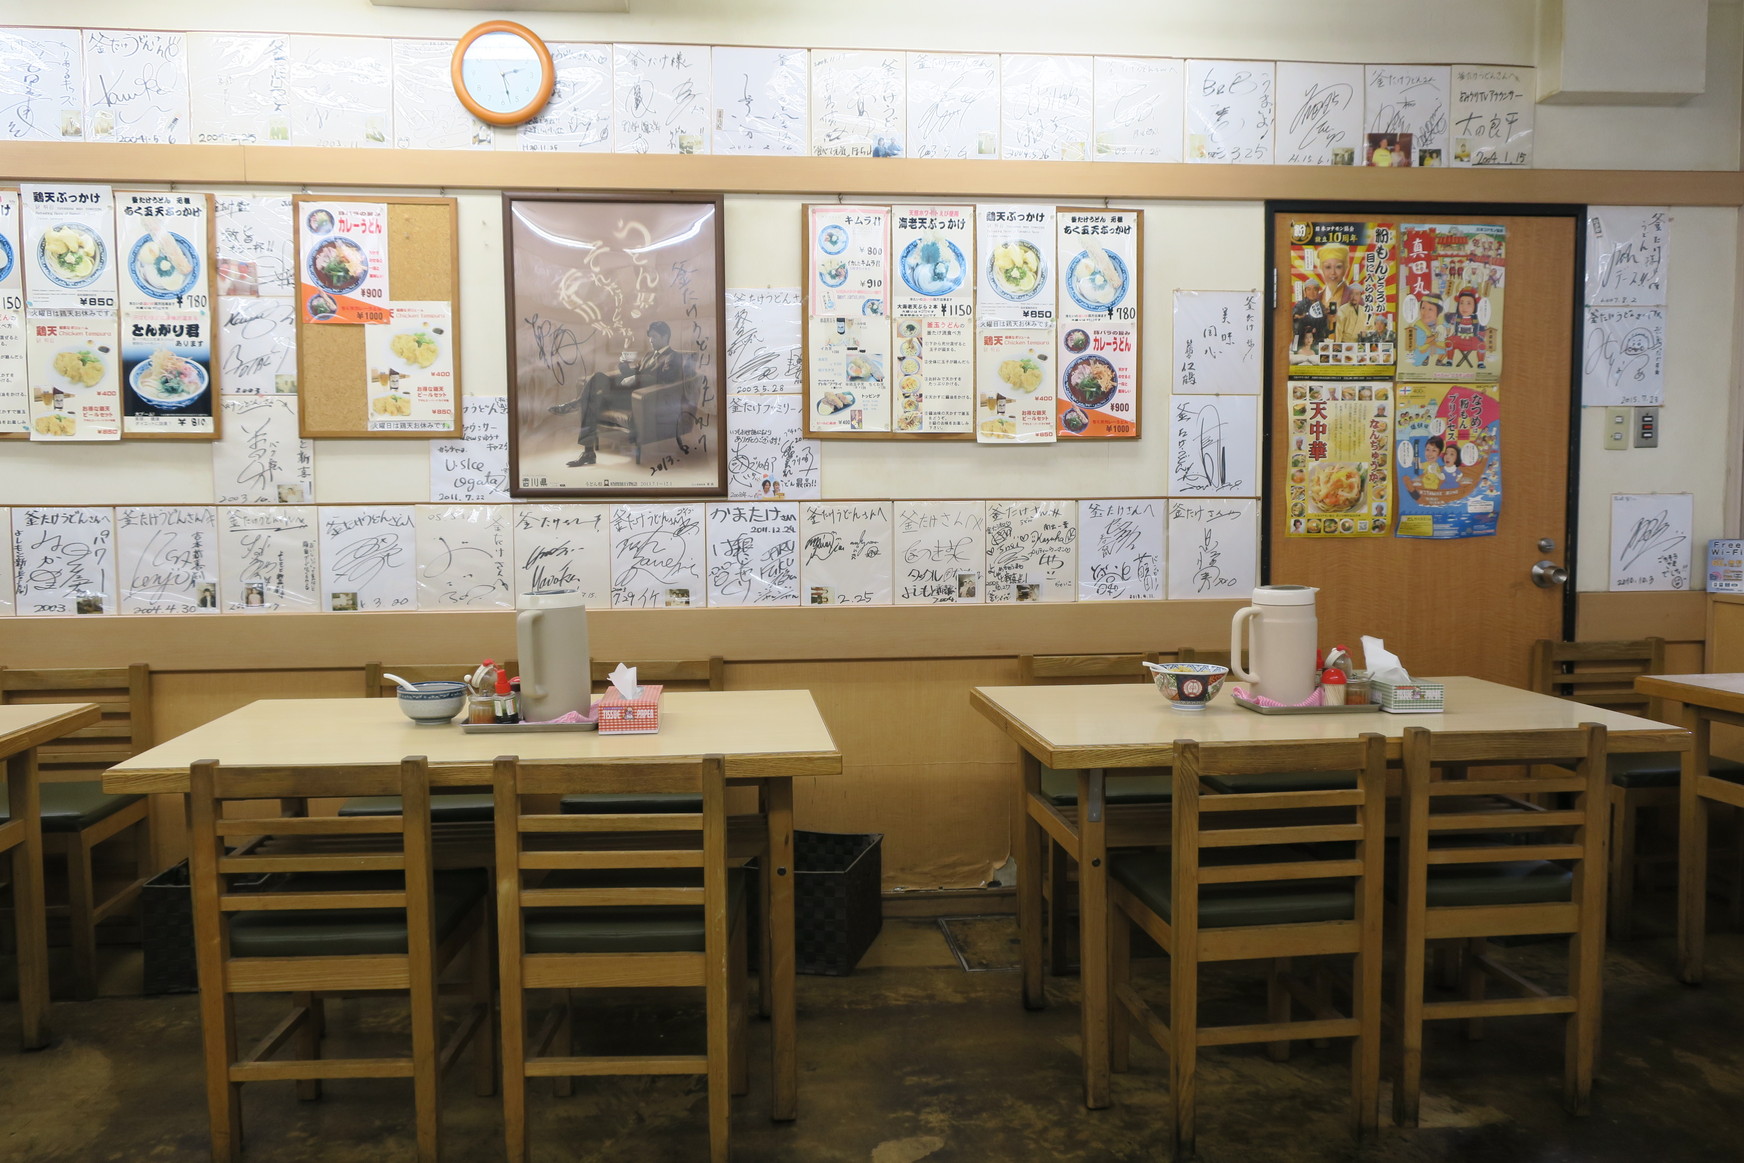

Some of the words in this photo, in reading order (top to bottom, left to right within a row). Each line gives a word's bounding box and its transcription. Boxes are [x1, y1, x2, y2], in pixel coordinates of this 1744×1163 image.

[33, 191, 100, 204] 鶏天ぶっかけ
[987, 211, 1045, 222] 鶏天ぶっかけ
[339, 217, 383, 234] カレーうどん
[898, 217, 967, 230] 海老天ぶっかけ
[1063, 226, 1132, 235] ちく玉天ぶっかけ
[1315, 232, 1358, 243] 設立10周年
[1374, 228, 1388, 313] 粉もんどころが
[1410, 238, 1430, 295] 真田丸
[361, 288, 383, 298] ¥900
[80, 298, 114, 306] ¥850
[356, 311, 383, 320] ¥1000
[941, 303, 972, 317] ¥1150
[1108, 307, 1136, 320] ¥780
[36, 326, 57, 337] 鶏天
[132, 324, 200, 338] とんがり君
[984, 336, 1003, 346] 鶏天
[1093, 336, 1132, 352] カレーうどん
[1110, 403, 1130, 412] ¥900
[1106, 425, 1130, 433] ¥1000
[1308, 401, 1328, 461] 天中華
[1369, 419, 1380, 483] なんちゅうか
